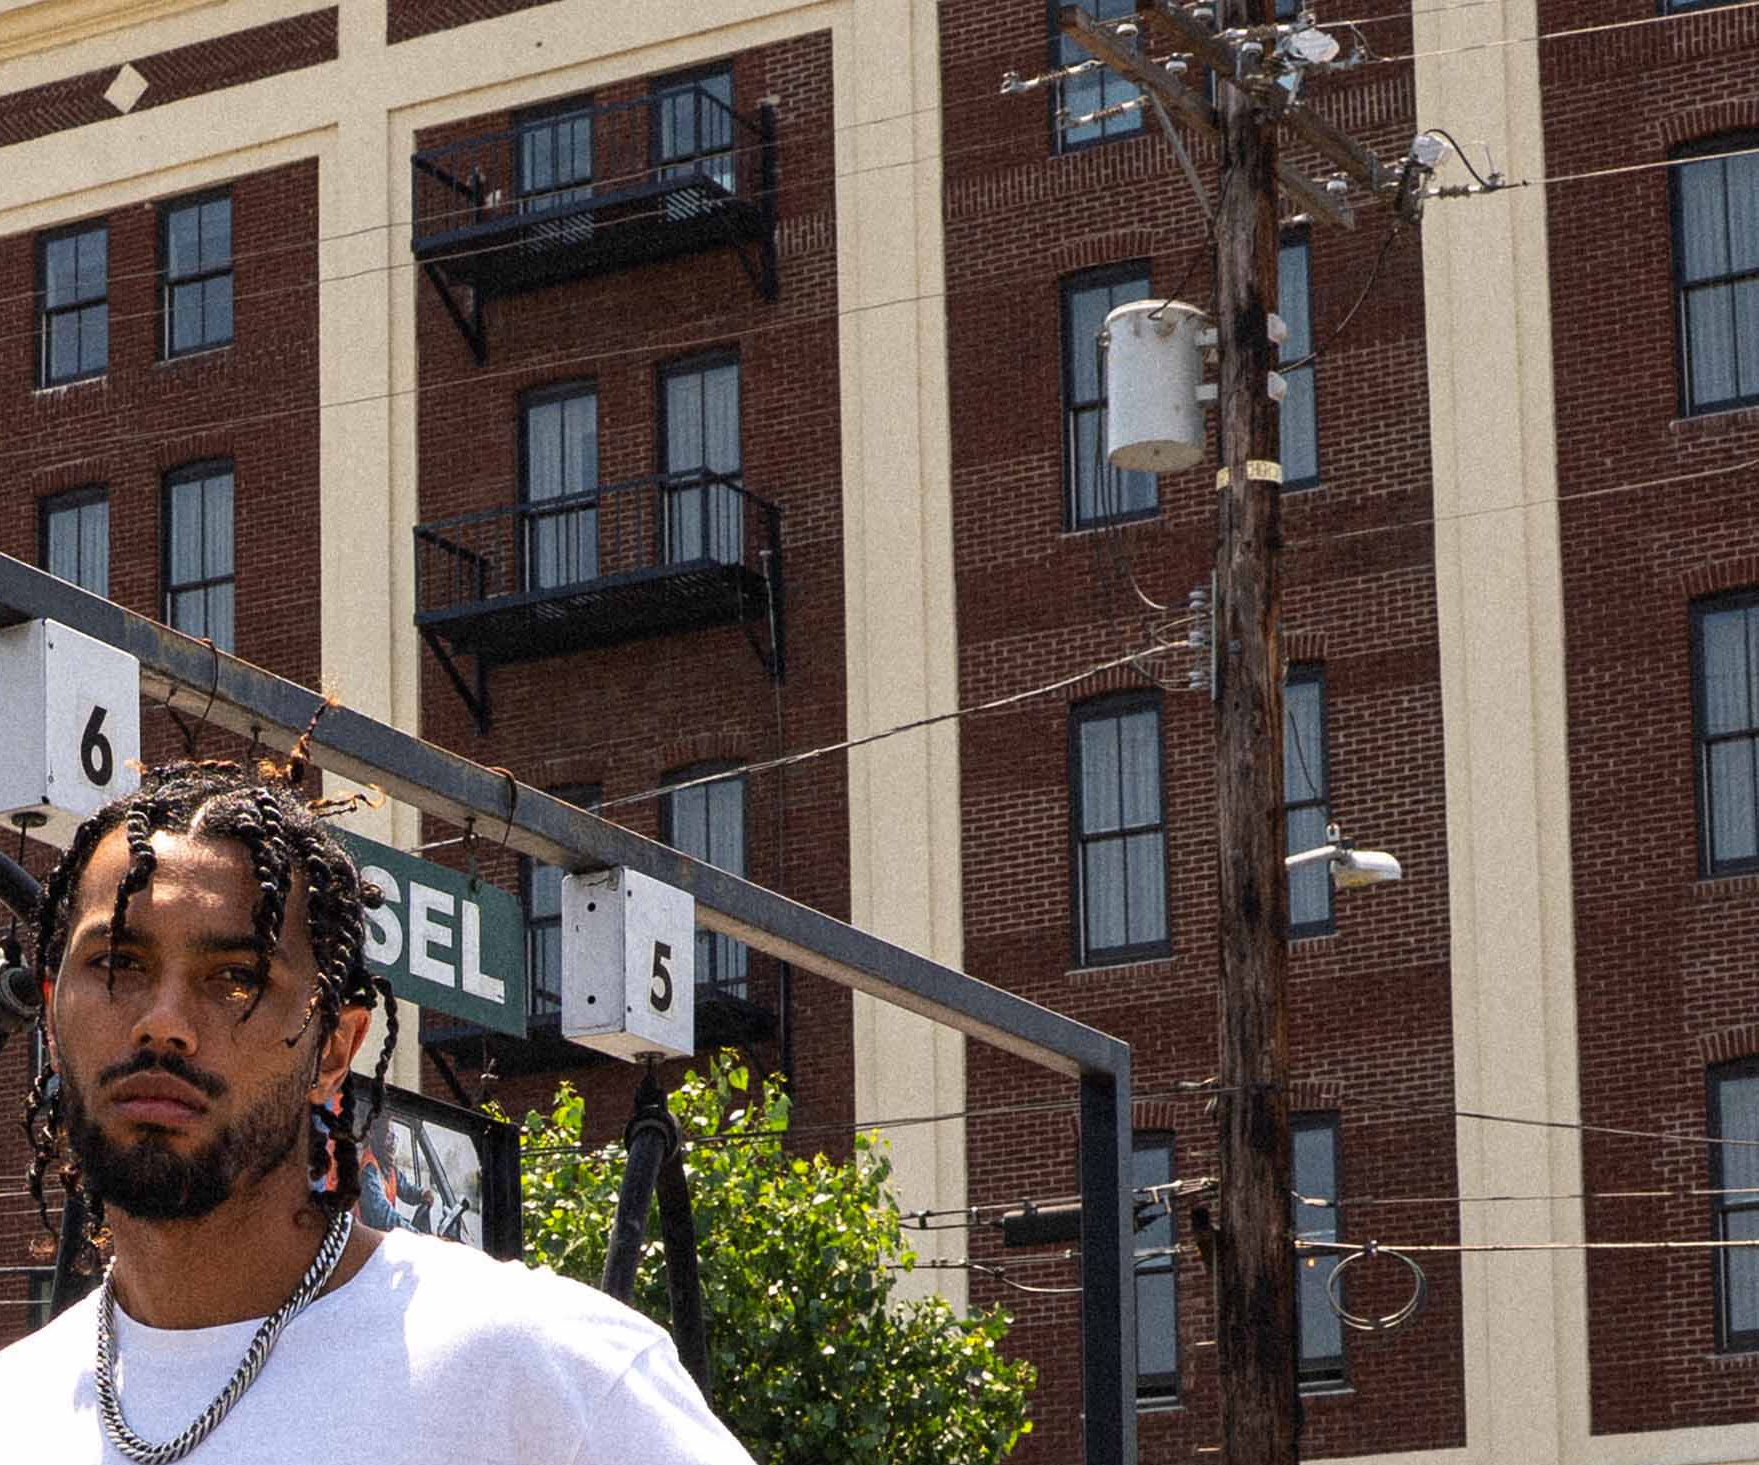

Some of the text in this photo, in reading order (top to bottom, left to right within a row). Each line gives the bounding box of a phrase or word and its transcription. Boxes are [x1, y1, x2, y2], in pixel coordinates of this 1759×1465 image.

[80, 705, 114, 786] 6
[359, 865, 505, 1005] SEL
[650, 941, 673, 1014] 5
